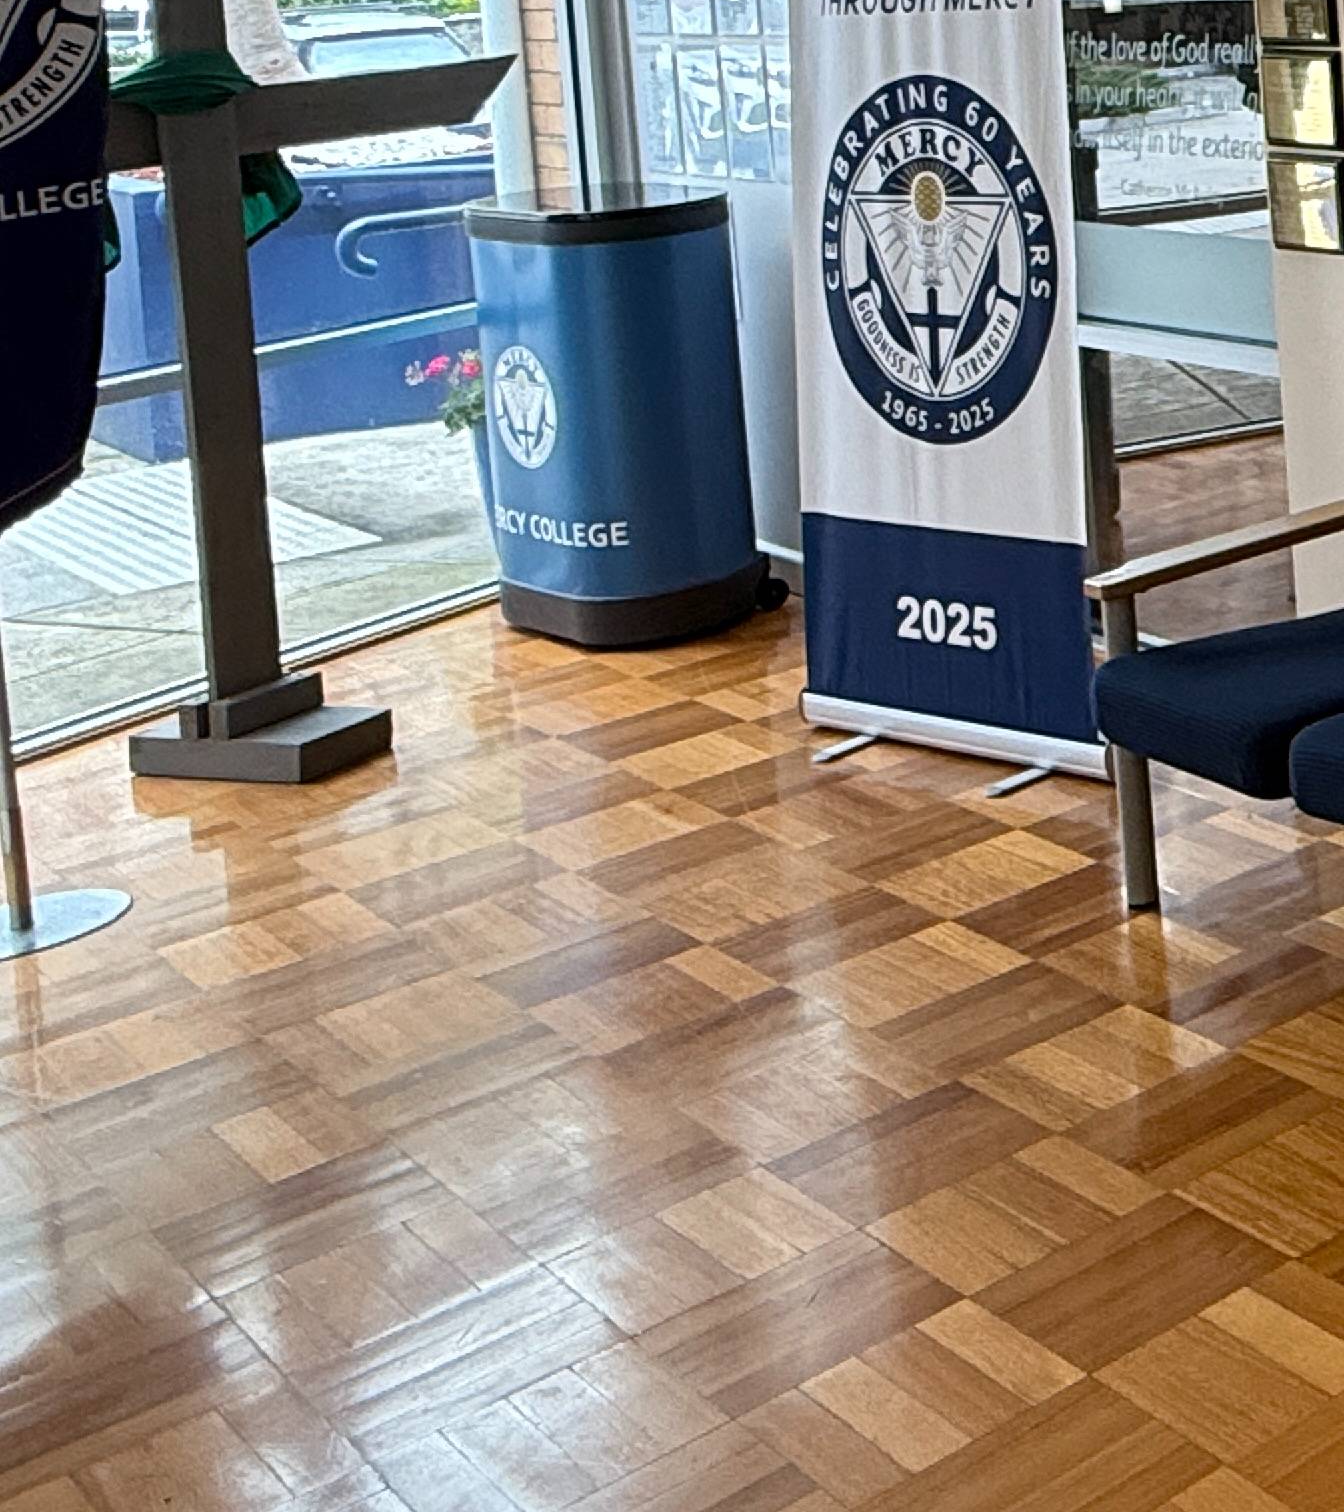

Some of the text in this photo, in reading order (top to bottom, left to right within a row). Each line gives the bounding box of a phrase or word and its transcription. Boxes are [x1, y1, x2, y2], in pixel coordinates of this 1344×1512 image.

[1081, 31, 1107, 59] the
[1111, 32, 1145, 62] love
[1150, 31, 1171, 68] of
[1172, 33, 1210, 64] God
[1214, 34, 1261, 74] reall
[0, 38, 85, 133] TRENGTH
[1094, 85, 1132, 115] your
[964, 101, 999, 141] 60
[1148, 134, 1163, 155] in
[1168, 126, 1198, 157] the
[1202, 132, 1264, 162] exterio
[875, 128, 987, 178] MERCY
[0, 177, 105, 221] LLEGE
[825, 84, 949, 292] CELEBRATING
[1005, 145, 1051, 300] YEARS
[857, 298, 907, 376] GOODNESS
[956, 315, 1010, 385] STRENGTH
[880, 390, 929, 432] 1965
[948, 399, 995, 434] 2025
[529, 514, 630, 548] COLLEGE
[896, 596, 998, 650] 2025
